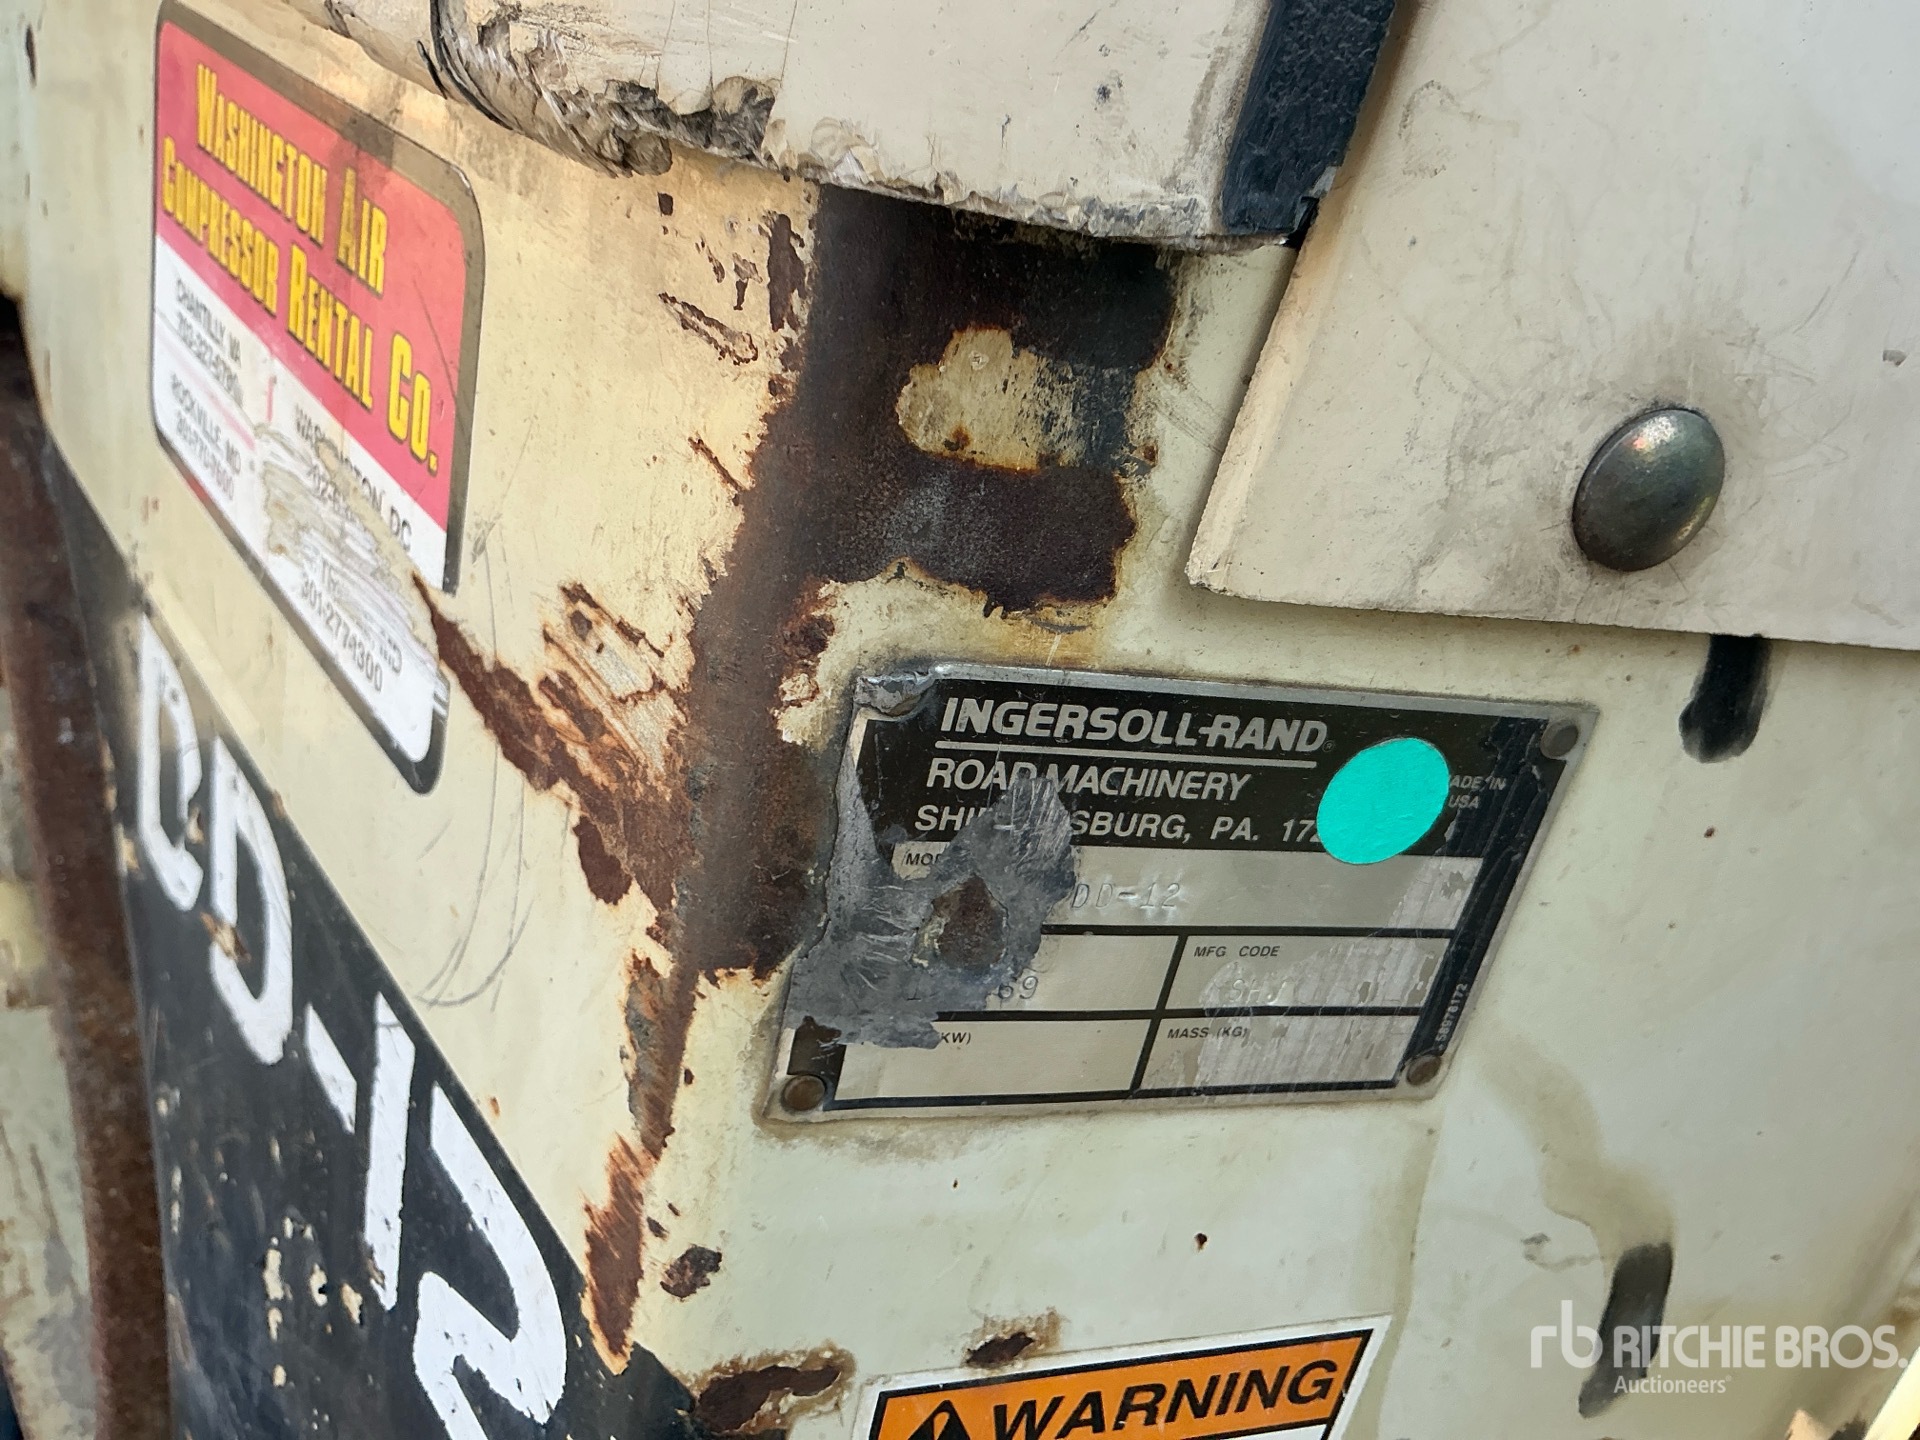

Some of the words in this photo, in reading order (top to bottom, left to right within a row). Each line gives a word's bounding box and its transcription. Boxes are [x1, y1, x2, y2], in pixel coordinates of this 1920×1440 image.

[197, 64, 328, 249] WASHINGTON
[337, 167, 388, 298] AIR
[162, 136, 280, 318] COMPRESSOR
[287, 243, 374, 414] RENTAL
[387, 332, 439, 476] CO.
[390, 505, 413, 552] DC
[940, 697, 1328, 752] INGERSOLL-RAND
[1046, 763, 1252, 802] MACHINERY
[1448, 773, 1484, 790] ADE
[1448, 794, 1480, 809] USA
[1210, 816, 1259, 841] PA.
[1194, 945, 1227, 957] MFG
[1238, 945, 1281, 957] CODE
[1166, 1026, 1210, 1039] MASS
[1216, 1025, 1248, 1039] (KG)
[992, 1358, 1338, 1440] WARNING
